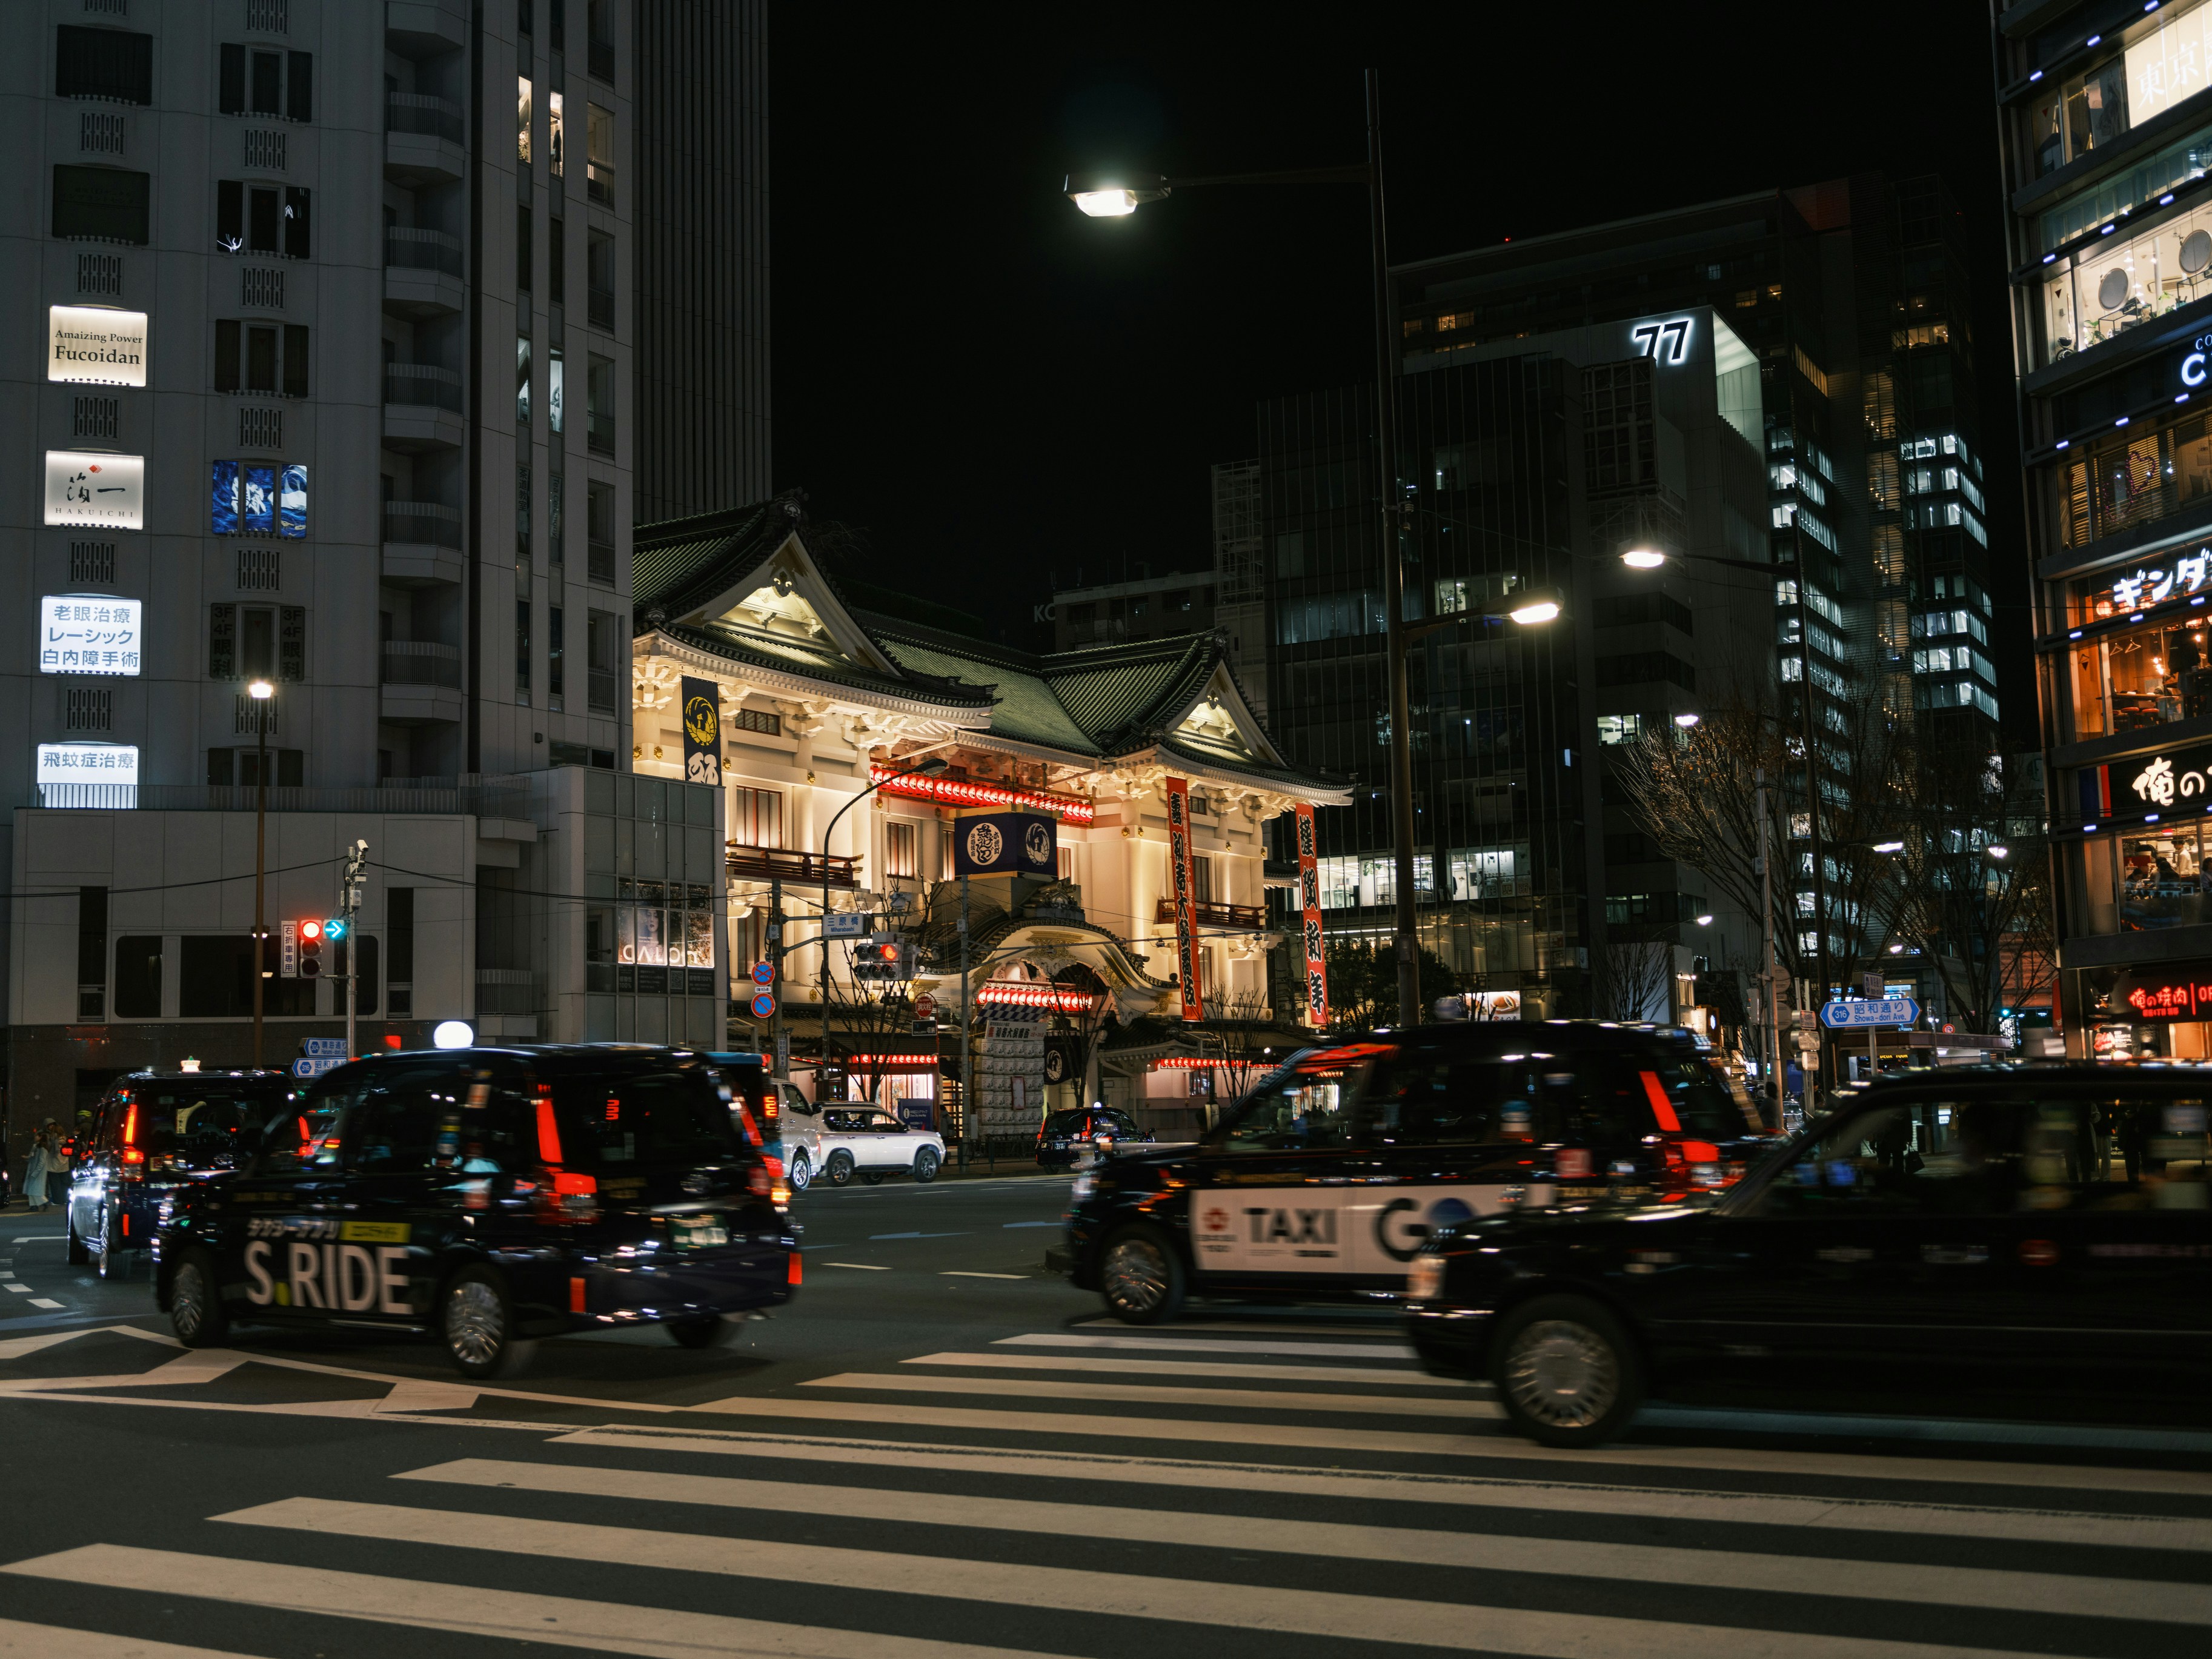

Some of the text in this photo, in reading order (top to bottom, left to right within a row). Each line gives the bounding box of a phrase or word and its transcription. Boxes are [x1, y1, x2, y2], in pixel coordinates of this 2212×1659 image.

[55, 330, 142, 343] Amaizing Power
[1635, 321, 1689, 360] 77
[55, 345, 140, 364] Fucoidan
[56, 508, 133, 517] HAKUICHI
[2113, 548, 2212, 607] ギンダ
[55, 605, 130, 623] 老眼治療
[50, 627, 133, 645] レーシック
[43, 649, 139, 667] 白内障手術
[44, 752, 134, 768] 飛蚊症治療
[2132, 756, 2212, 806] 俺の
[828, 916, 859, 926] 三原橋
[285, 926, 293, 972] 右折車専用
[2129, 986, 2188, 1009] 俺の焼肉
[1835, 1010, 1847, 1019] 316
[1854, 1002, 1904, 1014] 昭和通り
[1893, 1012, 1907, 1021] Ave.
[1243, 1208, 1338, 1244] TAXI
[244, 1240, 414, 1315] S.RIDE
